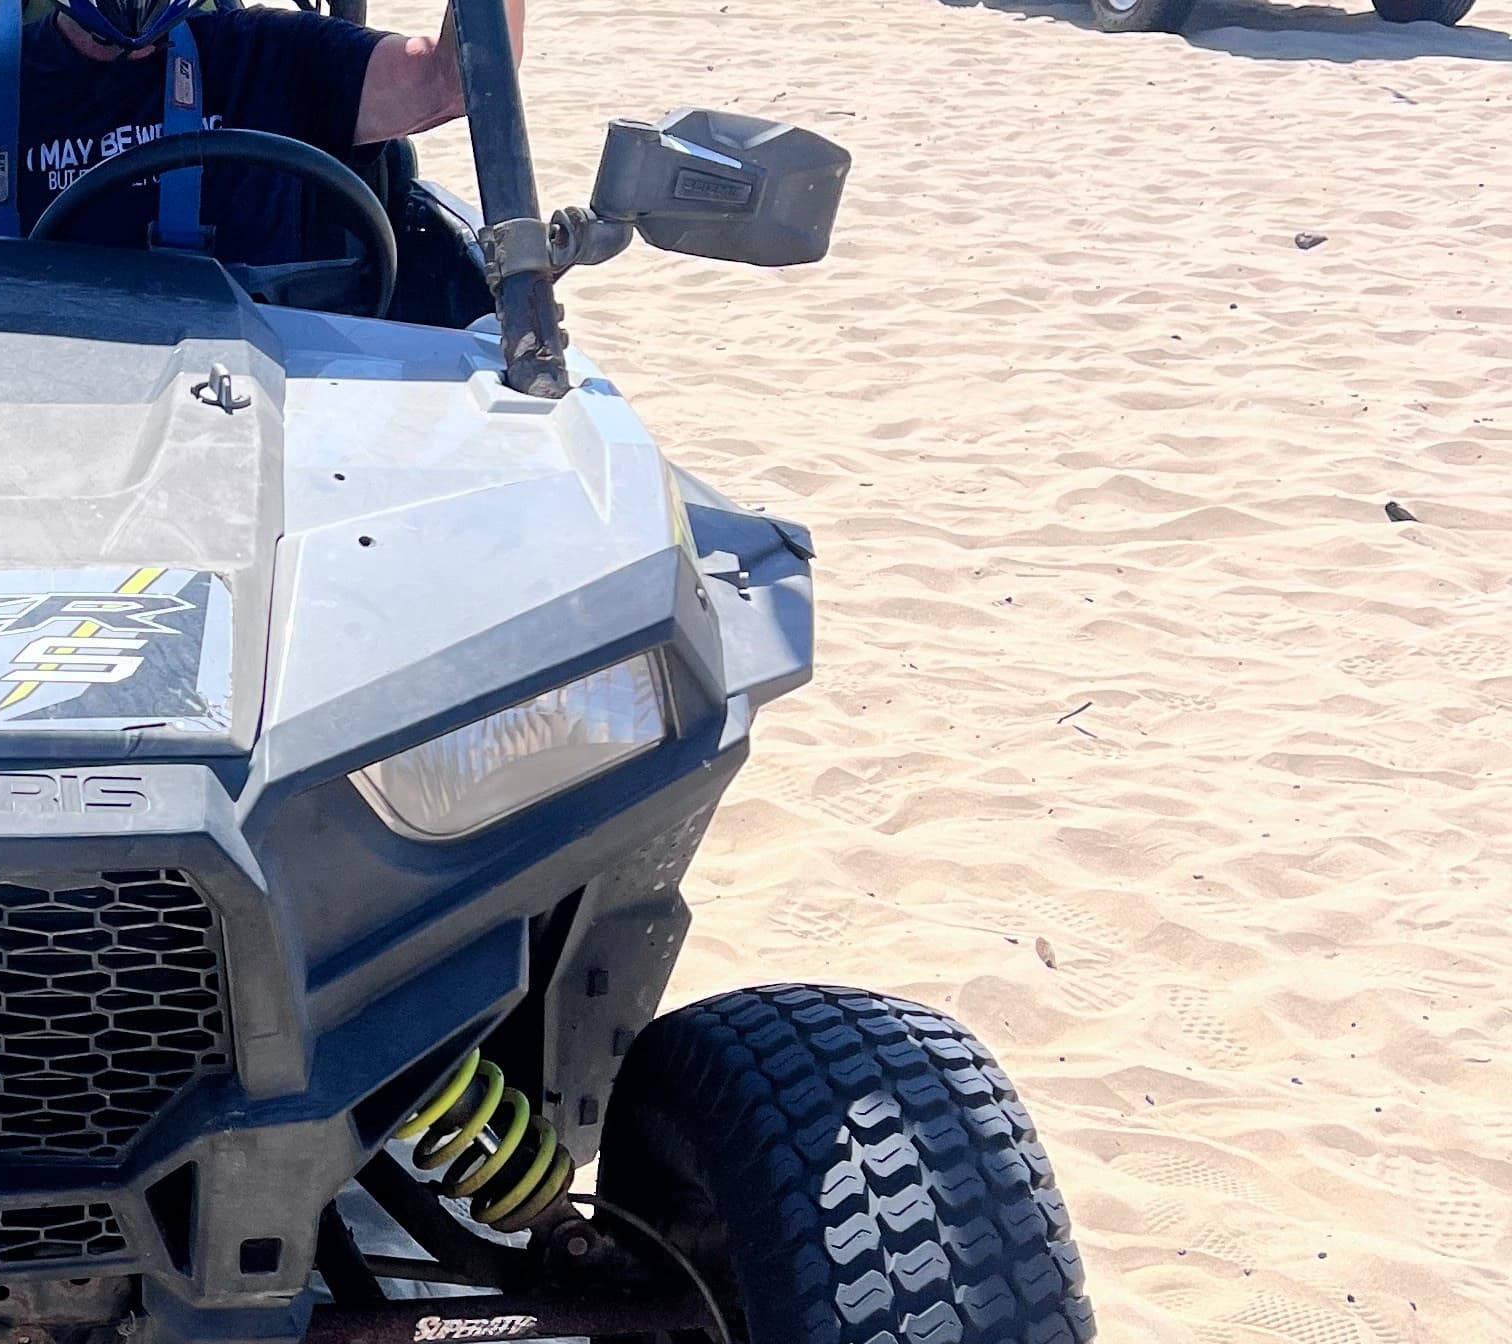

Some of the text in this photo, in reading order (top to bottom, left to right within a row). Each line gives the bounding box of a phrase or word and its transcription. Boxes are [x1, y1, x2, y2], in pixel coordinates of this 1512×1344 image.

[40, 138, 94, 171] MAY
[101, 125, 133, 157] BE
[48, 169, 76, 190] BUT
